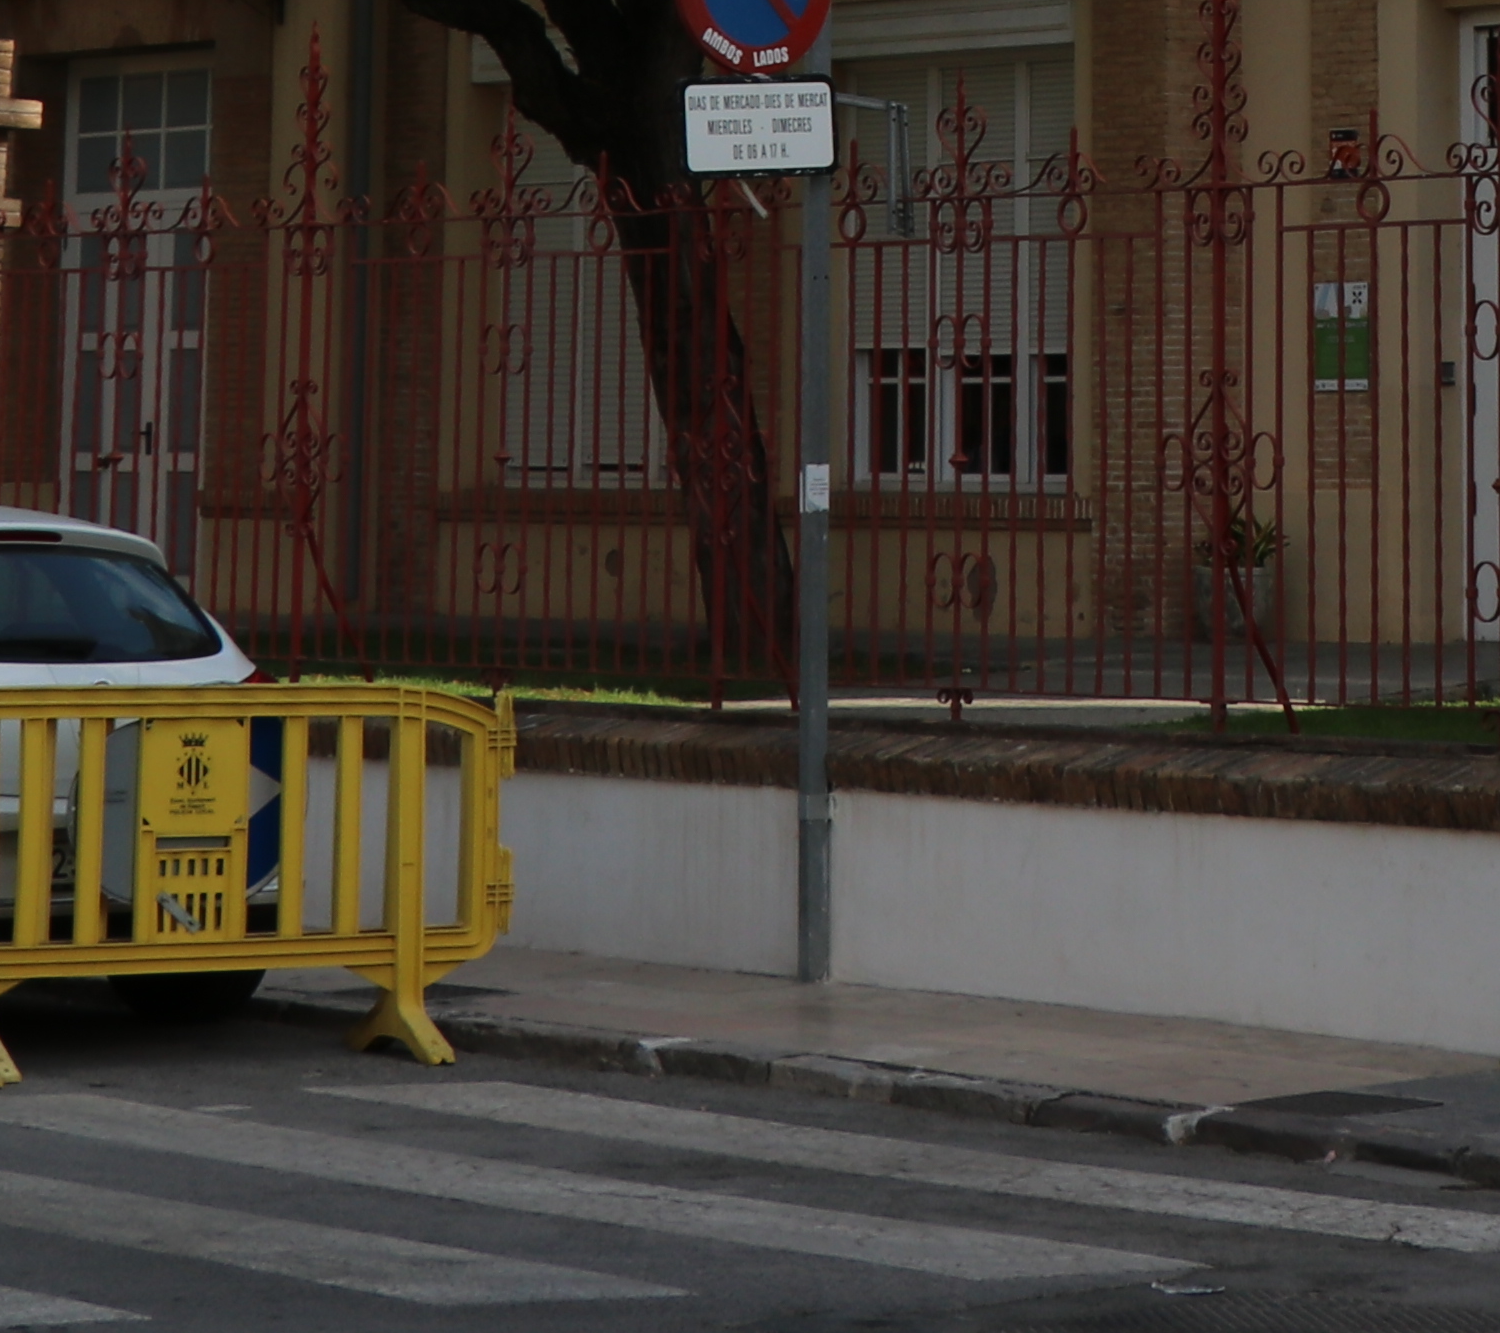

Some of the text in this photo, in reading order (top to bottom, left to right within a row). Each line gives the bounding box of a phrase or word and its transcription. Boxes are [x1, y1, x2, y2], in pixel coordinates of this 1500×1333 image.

[702, 27, 790, 68] AMBOS LADOS
[688, 96, 707, 111] DIAS
[710, 95, 720, 110] DE
[785, 93, 795, 108] DE
[798, 92, 828, 107] MERCAT
[707, 118, 752, 135] MIERCOLES
[772, 117, 812, 133] DIMECRES
[733, 144, 744, 160] DE
[761, 144, 768, 158] A
[770, 143, 778, 158] 17
